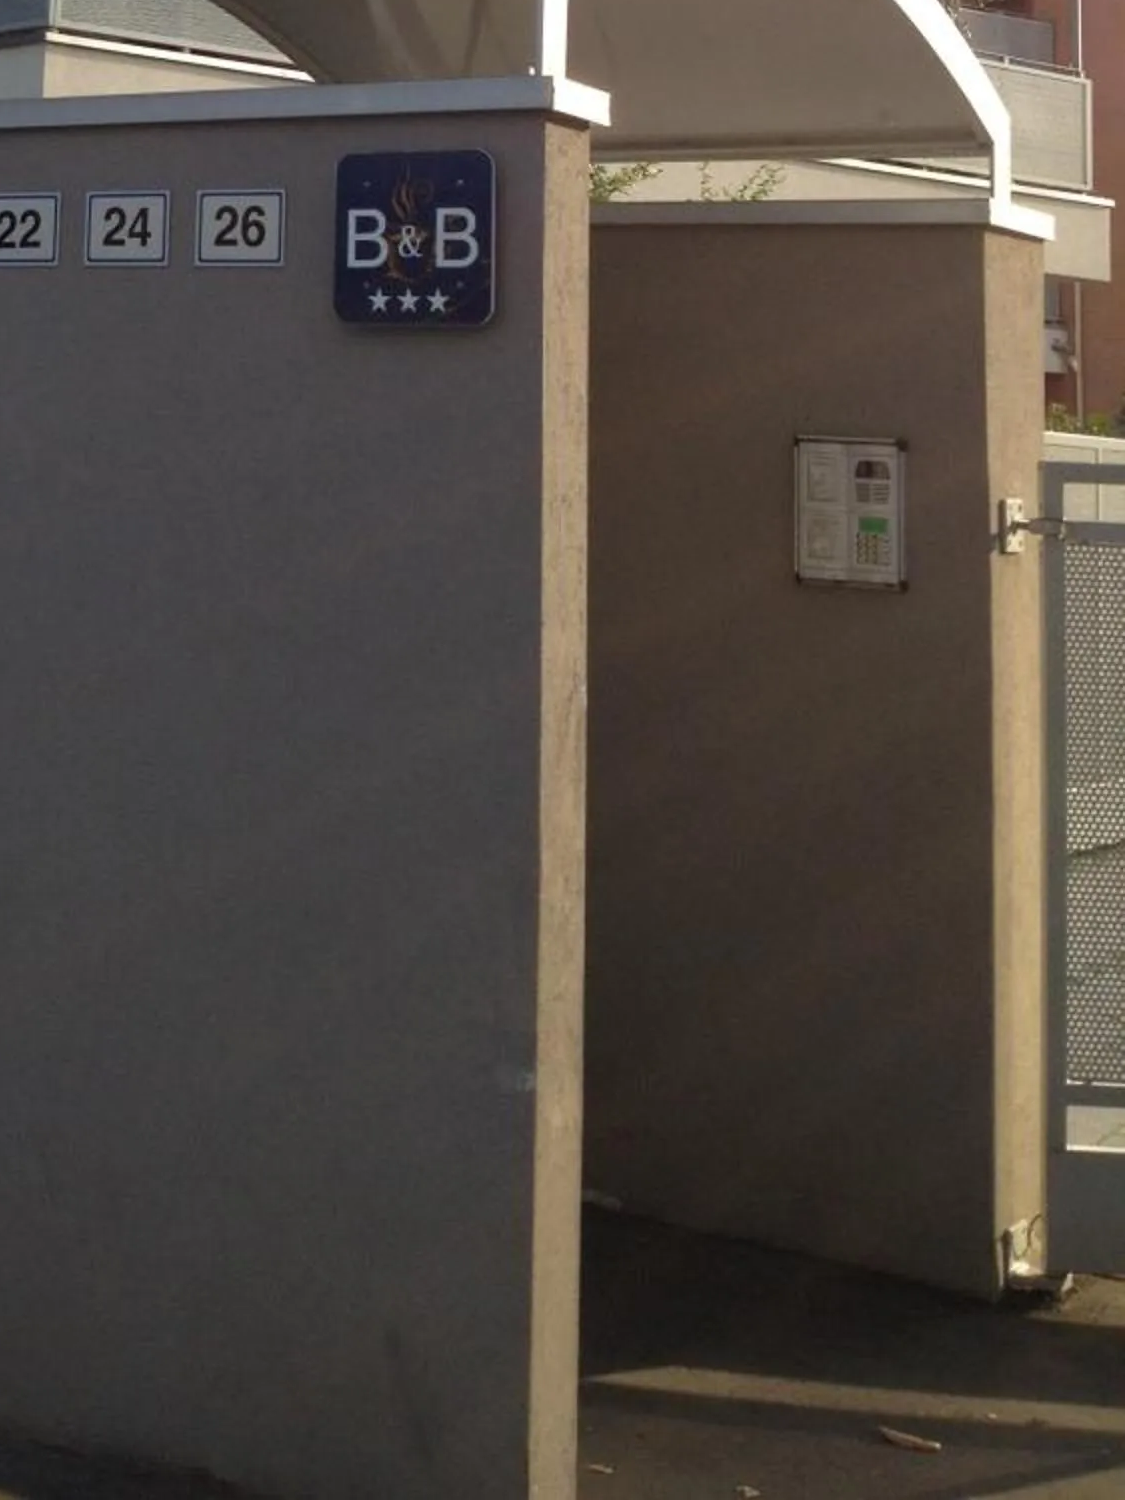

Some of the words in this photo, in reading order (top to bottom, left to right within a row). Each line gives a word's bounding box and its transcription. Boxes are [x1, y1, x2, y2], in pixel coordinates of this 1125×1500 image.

[102, 206, 151, 247] 24
[213, 204, 266, 247] 26
[346, 207, 479, 269] B&B
